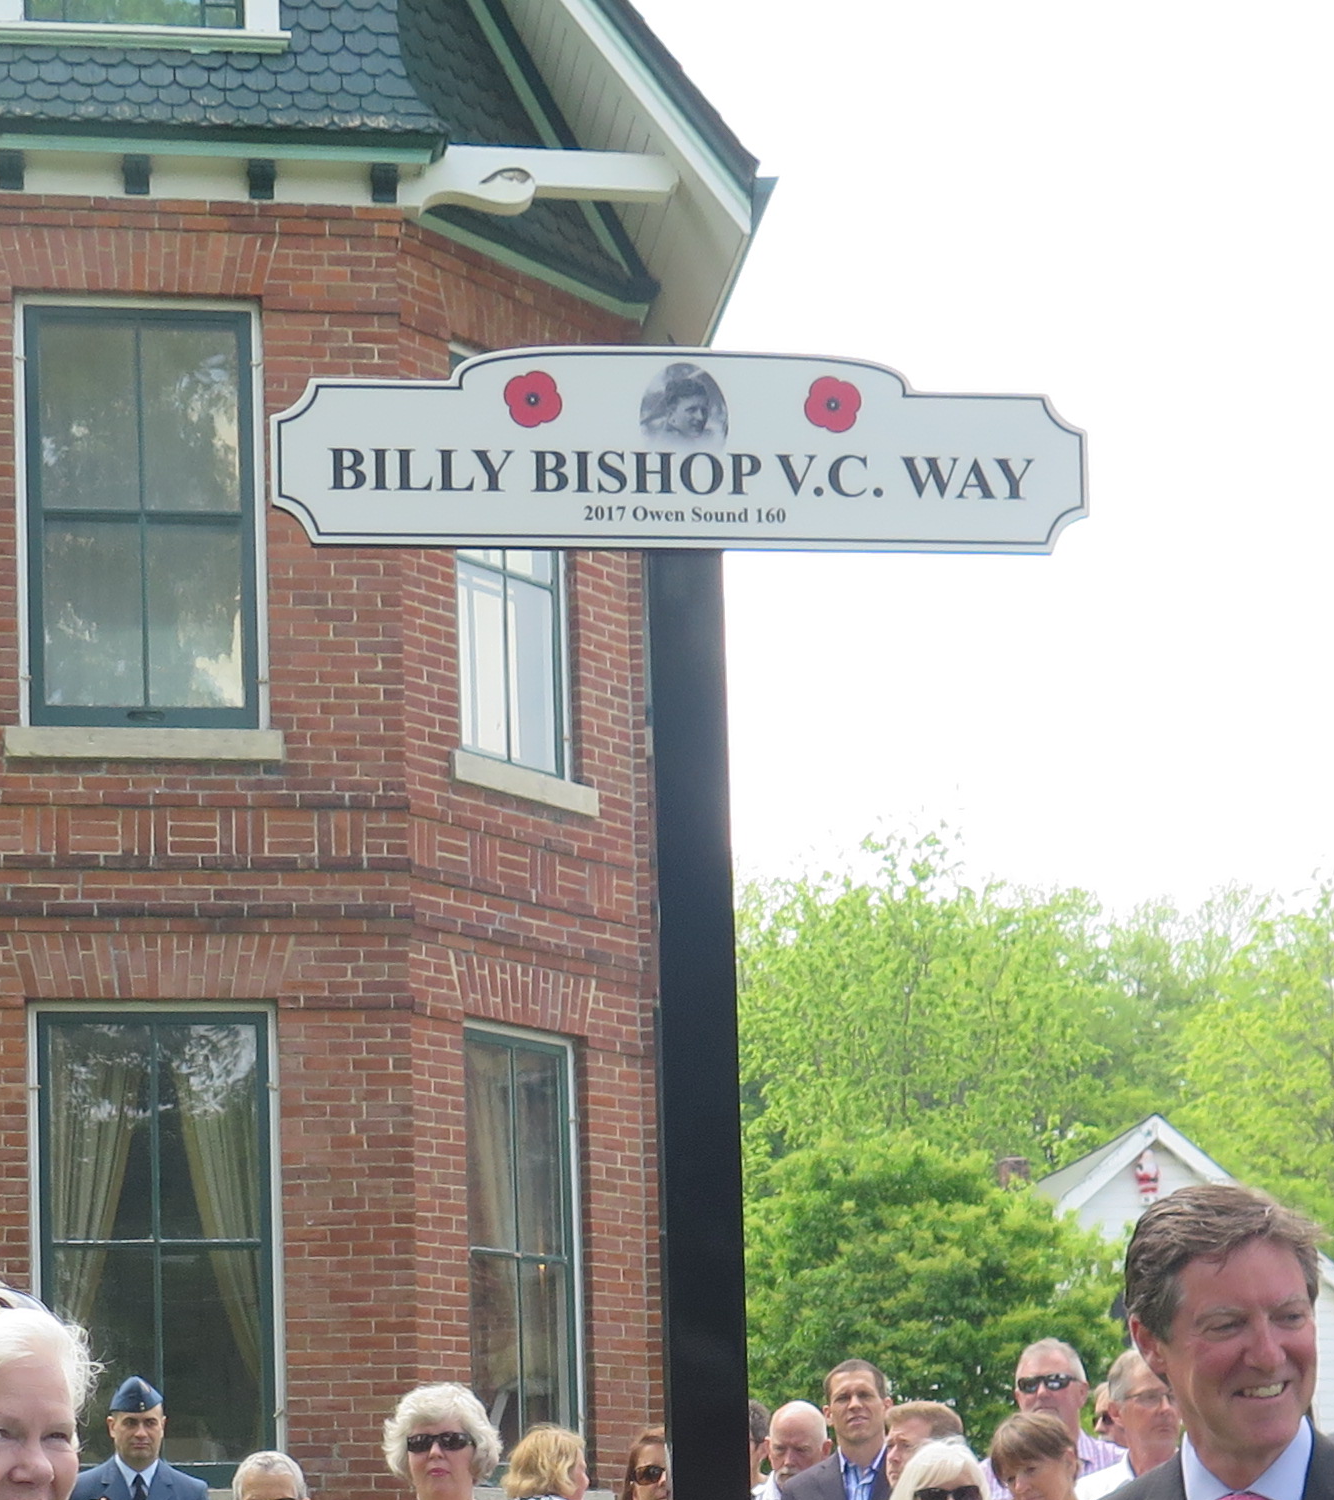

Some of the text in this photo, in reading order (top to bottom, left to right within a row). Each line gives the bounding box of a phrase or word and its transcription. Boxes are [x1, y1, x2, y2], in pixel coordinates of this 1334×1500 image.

[328, 446, 1034, 501] BILLY BISHOP V.C. WAY
[583, 505, 786, 523] 2017 Owen Sound 160
